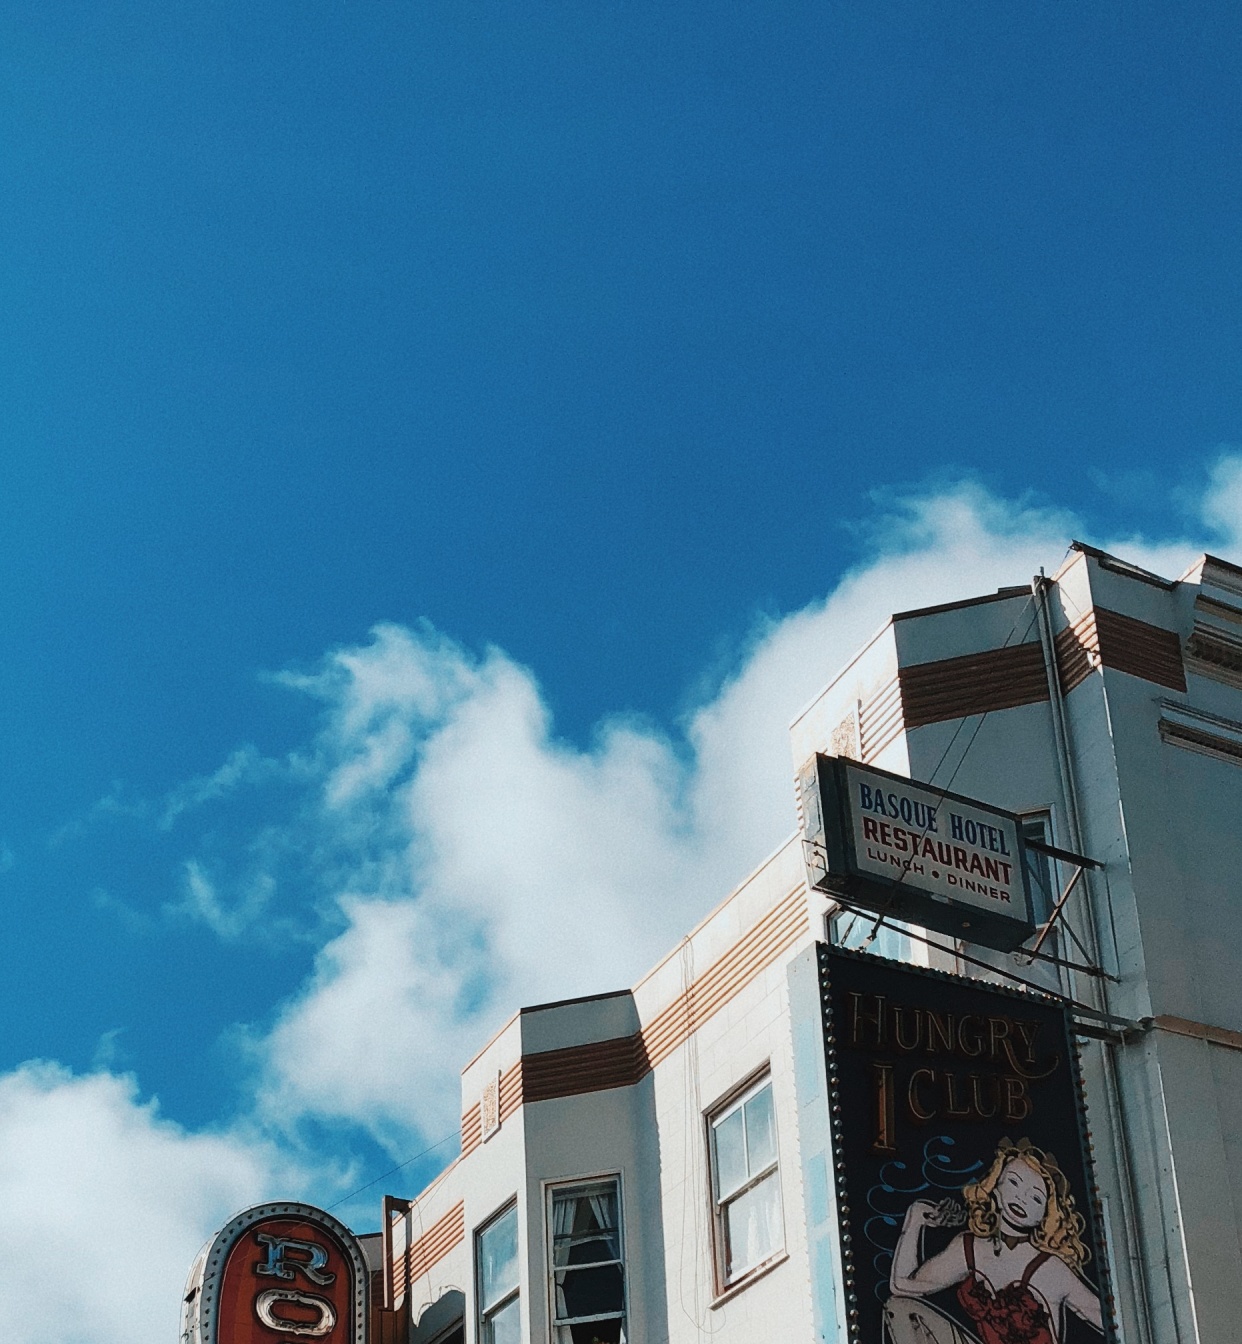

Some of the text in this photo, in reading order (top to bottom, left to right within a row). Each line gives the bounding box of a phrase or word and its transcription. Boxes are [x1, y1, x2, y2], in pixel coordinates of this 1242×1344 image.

[859, 782, 1011, 857] BASQUE HOTEL
[862, 816, 1013, 886] RESTAURANT
[867, 847, 1012, 904] LUNCH DINNER
[848, 991, 1060, 1079] HUNGRY
[907, 1067, 1034, 1122] CLUB
